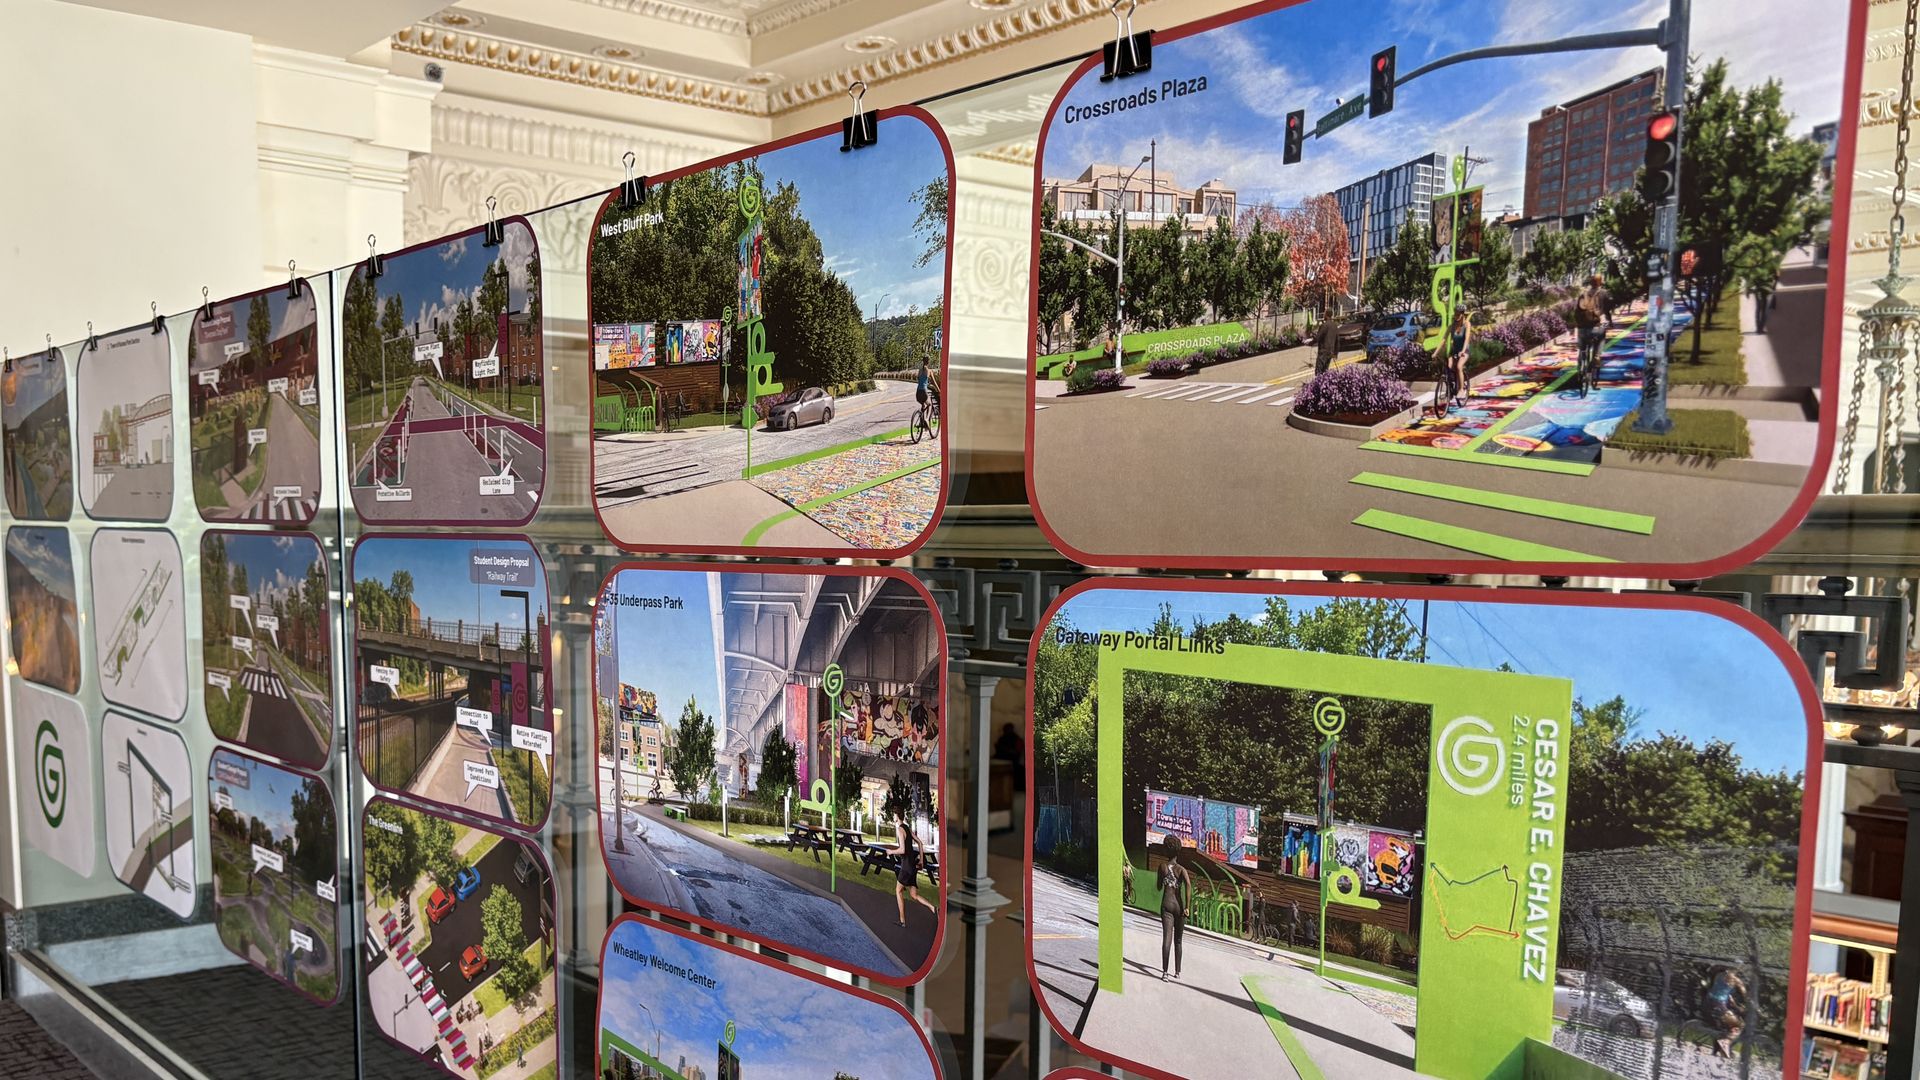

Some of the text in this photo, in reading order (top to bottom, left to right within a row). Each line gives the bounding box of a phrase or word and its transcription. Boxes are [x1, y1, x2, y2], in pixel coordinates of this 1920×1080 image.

[1065, 75, 1207, 124] Crossroads Plaza
[600, 210, 664, 238] West Bluff Park
[1147, 332, 1246, 353] CROSSROADS PLAZA
[473, 555, 493, 566] Student
[493, 556, 510, 568] Design
[619, 593, 662, 611] Underpass
[663, 595, 684, 610] Park
[1055, 626, 1225, 655] Gateway Portal Links
[460, 709, 482, 718] Connection
[516, 728, 530, 738] Native
[466, 764, 495, 777] Improved Path
[1511, 714, 1530, 806] 2.4 miles
[469, 773, 492, 784] Conditions
[368, 814, 404, 835] The Greenline
[1522, 718, 1560, 984] CESAR E. CHAVEZ
[613, 940, 717, 990] Wheatley Welcome Center
